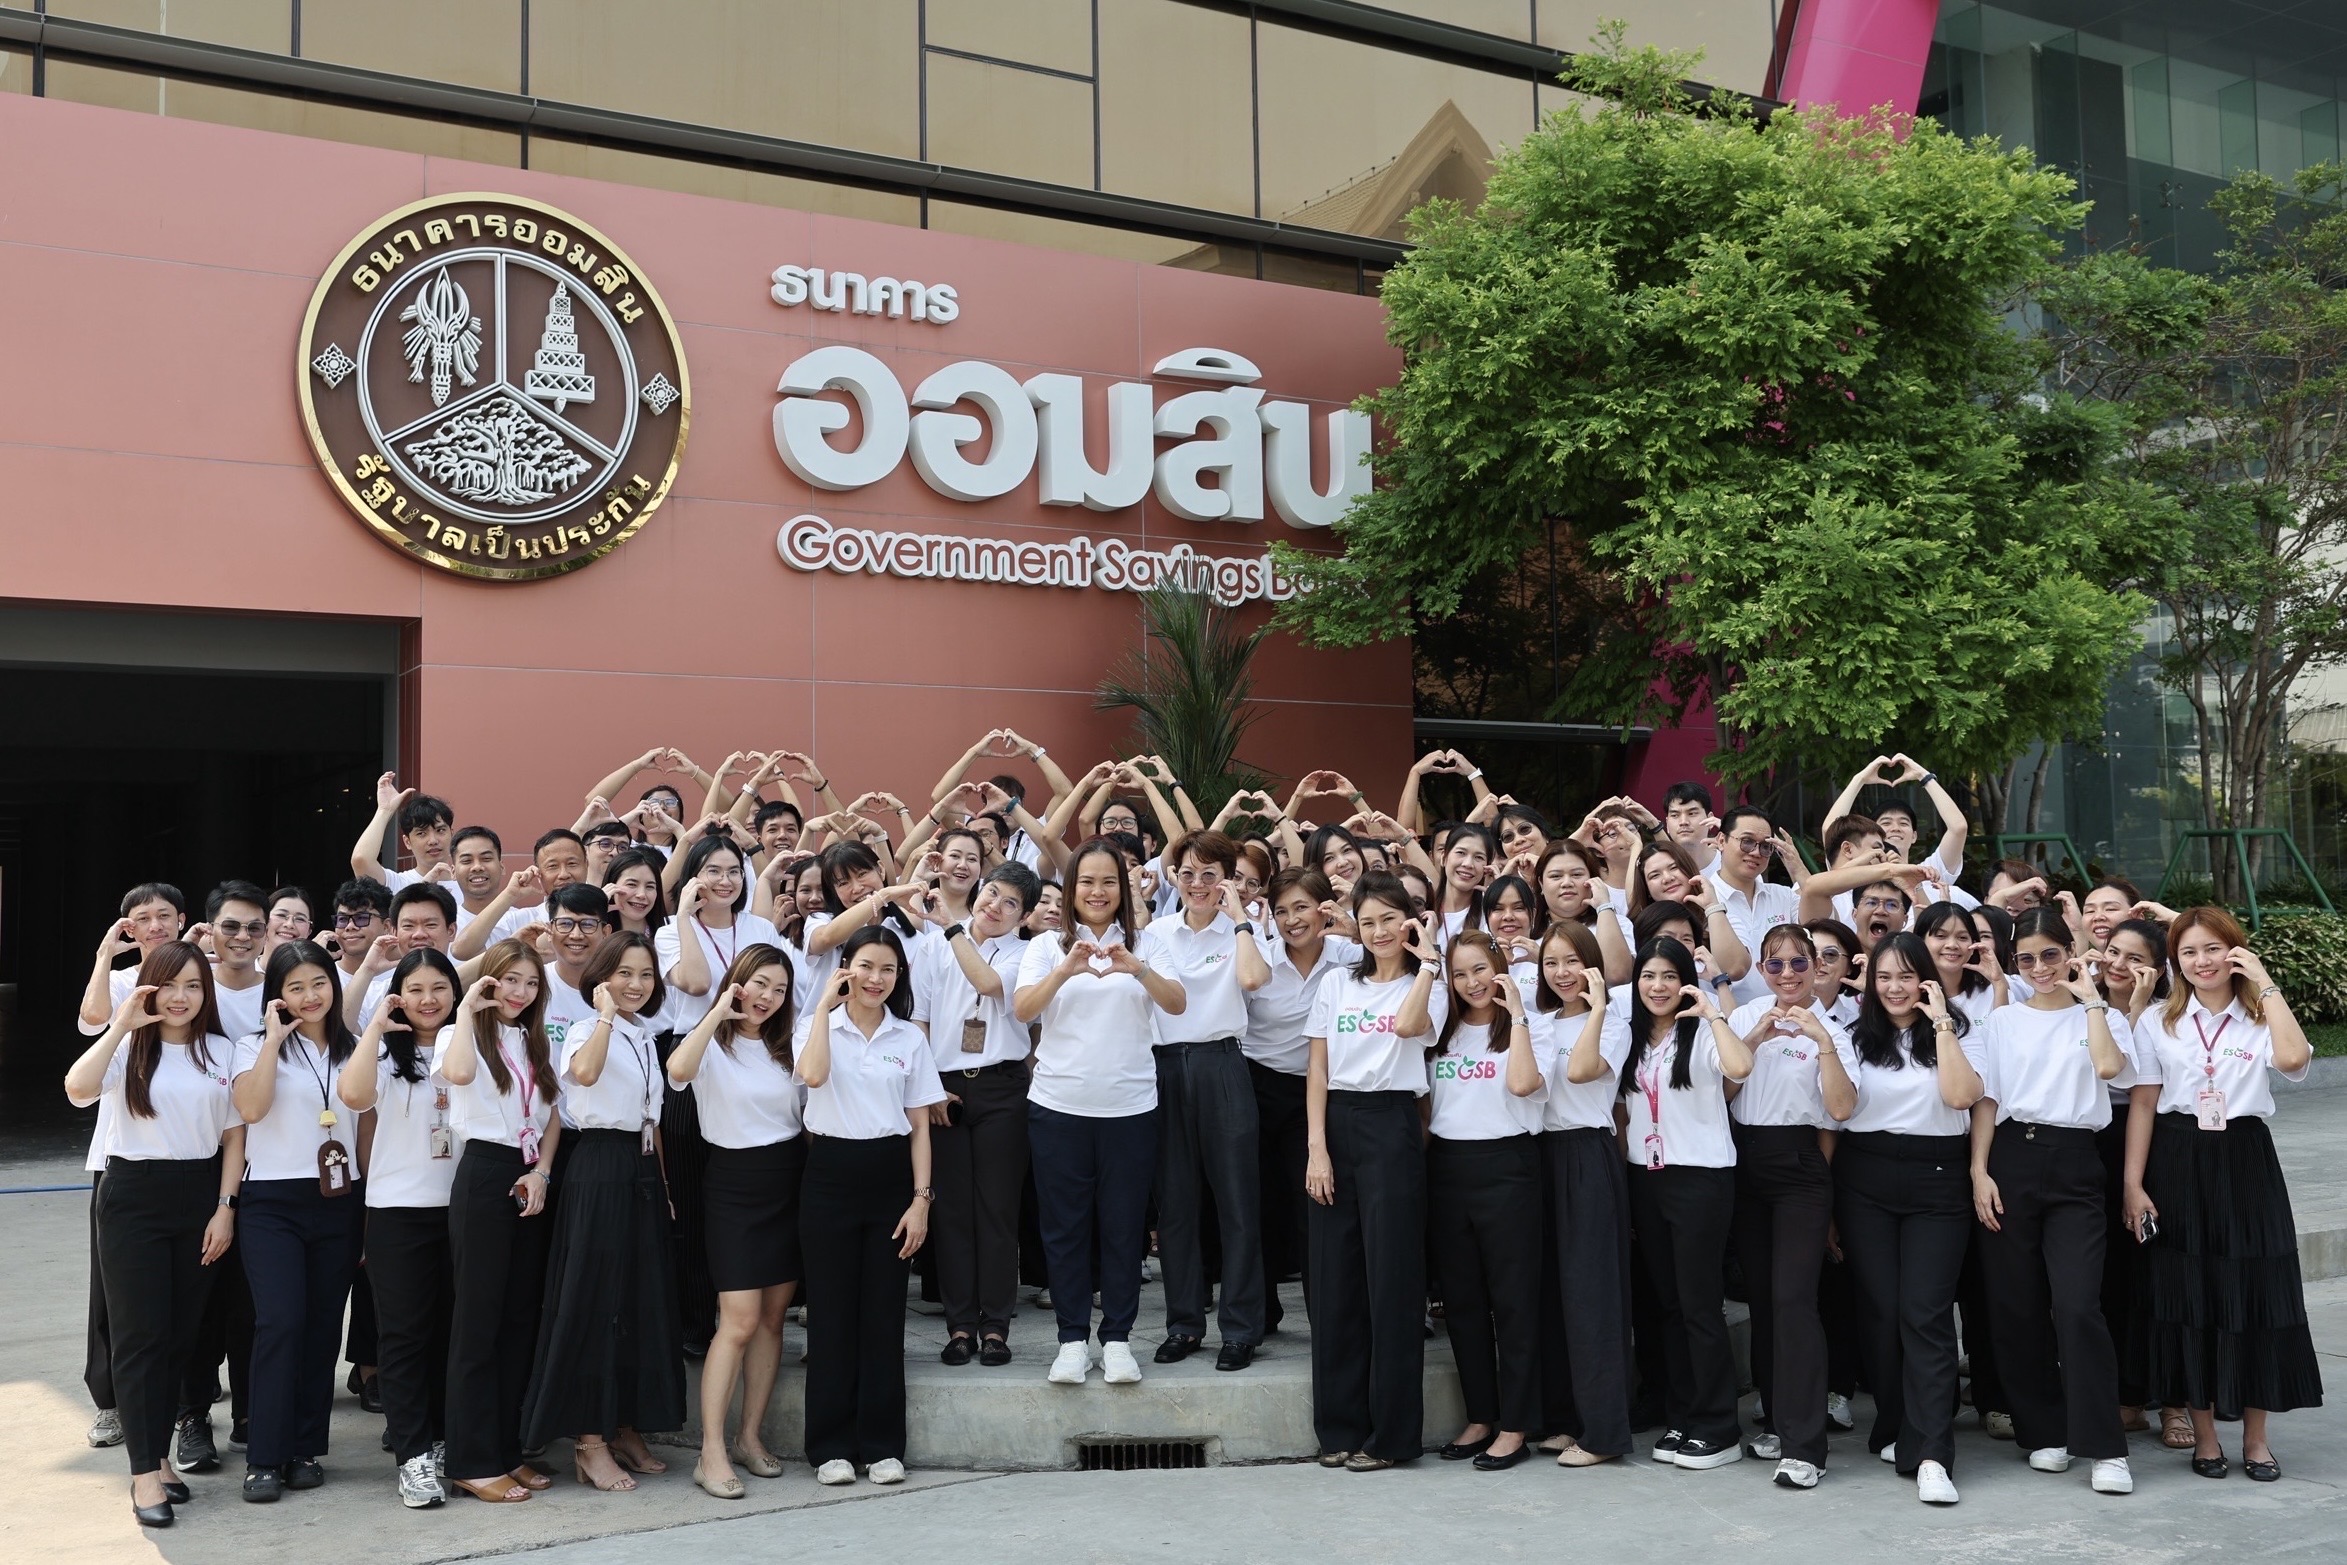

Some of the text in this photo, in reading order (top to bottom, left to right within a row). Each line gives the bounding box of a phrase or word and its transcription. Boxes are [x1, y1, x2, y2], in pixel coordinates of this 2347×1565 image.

[352, 214, 644, 324] ธนาคารออมสิน
[771, 265, 960, 325] ธนาคาร
[773, 346, 1373, 530] ออมสิน
[355, 453, 652, 560] รัฐบาลเป็นประกัน
[778, 516, 1095, 588] Government
[1097, 539, 1263, 606] Savings
[1435, 1056, 1496, 1080] ESGSB
[2223, 1047, 2253, 1062] ESGSB
